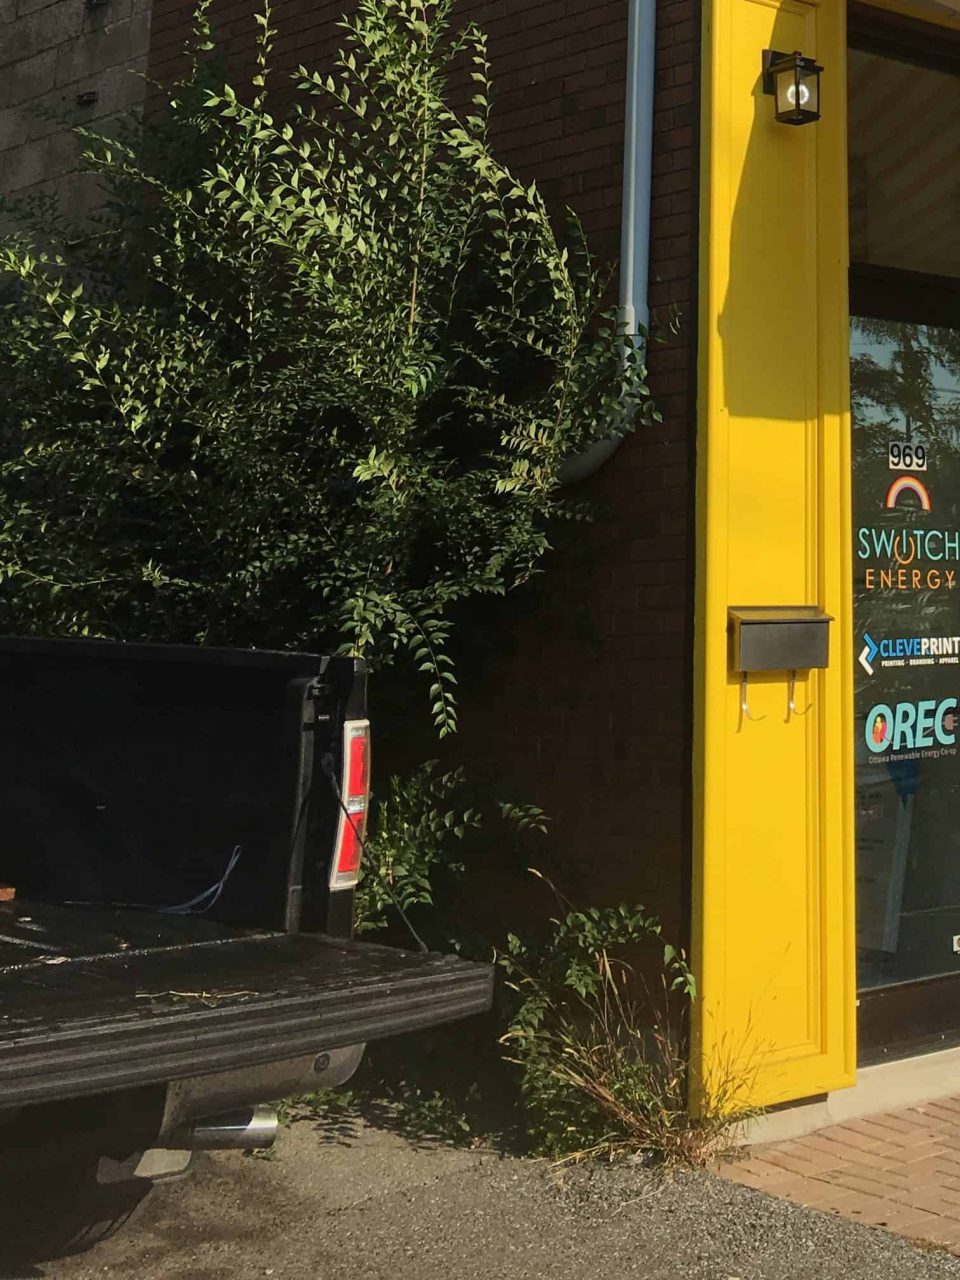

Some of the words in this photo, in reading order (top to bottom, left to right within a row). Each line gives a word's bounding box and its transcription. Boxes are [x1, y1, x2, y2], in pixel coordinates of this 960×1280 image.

[890, 443, 926, 468] 969
[858, 527, 960, 564] SWITCH
[865, 568, 955, 589] ENERGY
[865, 697, 958, 753] OREC
[868, 755, 890, 764] Ottawa
[890, 751, 921, 761] Renewable
[921, 749, 941, 759] Energy
